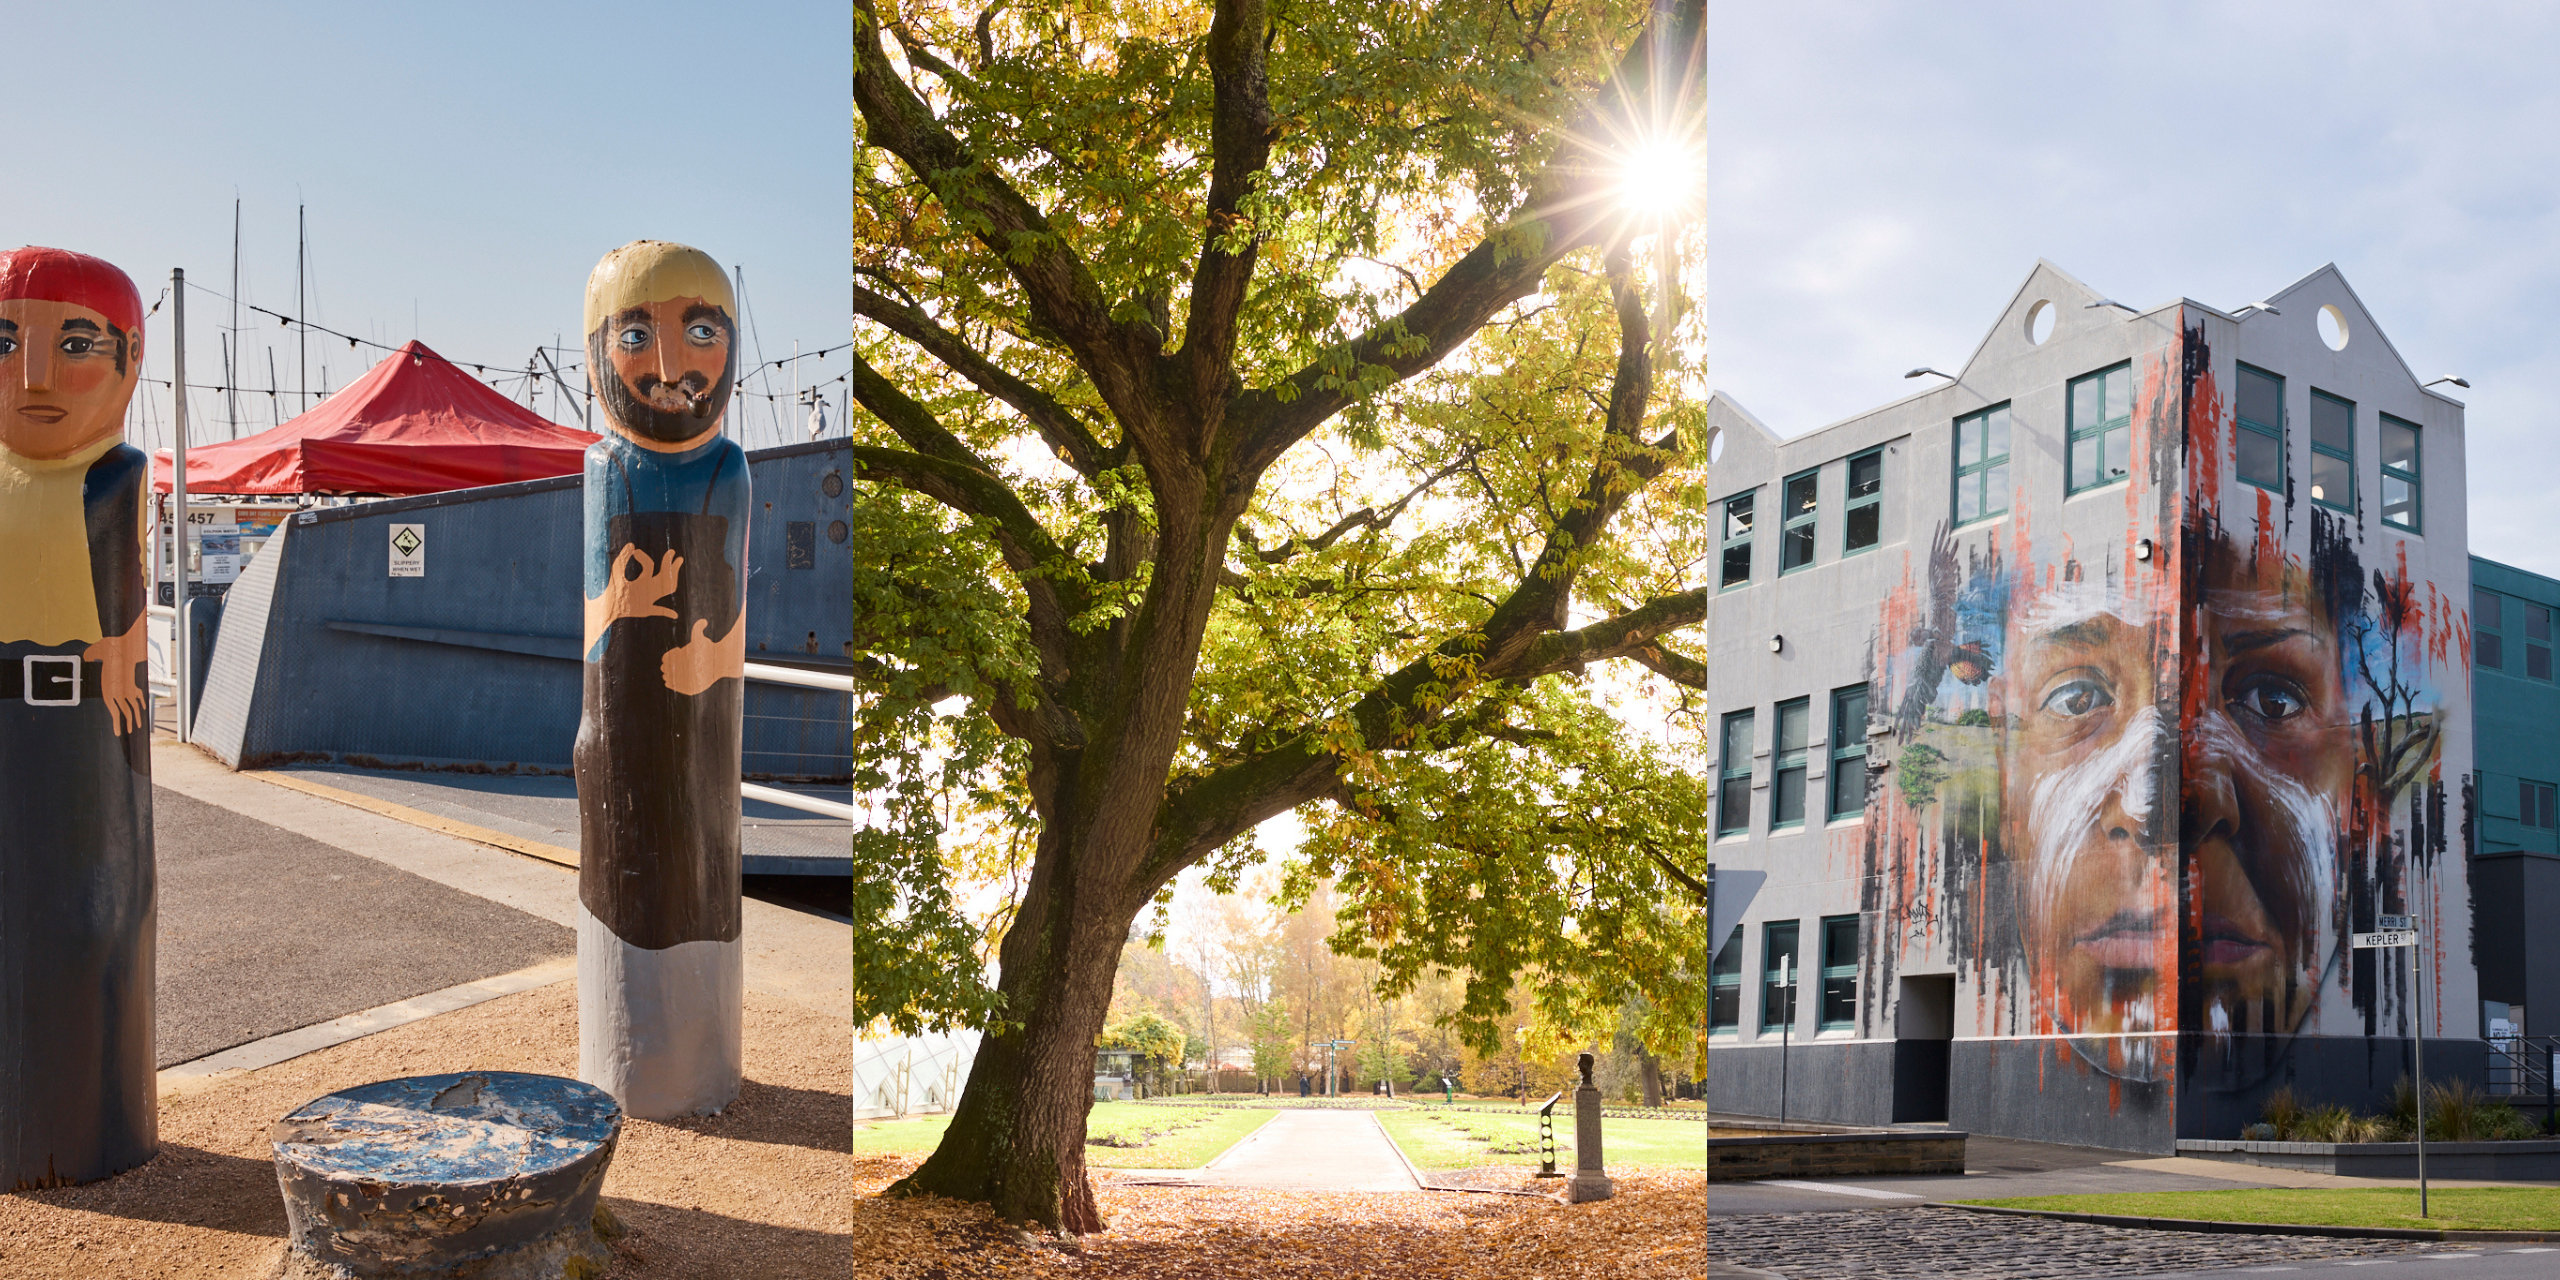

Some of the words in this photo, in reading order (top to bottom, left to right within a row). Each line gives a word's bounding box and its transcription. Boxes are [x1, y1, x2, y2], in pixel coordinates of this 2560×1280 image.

[2378, 916, 2397, 928] MERRI
[2400, 917, 2407, 928] ST
[2366, 934, 2399, 946] KEPLER
